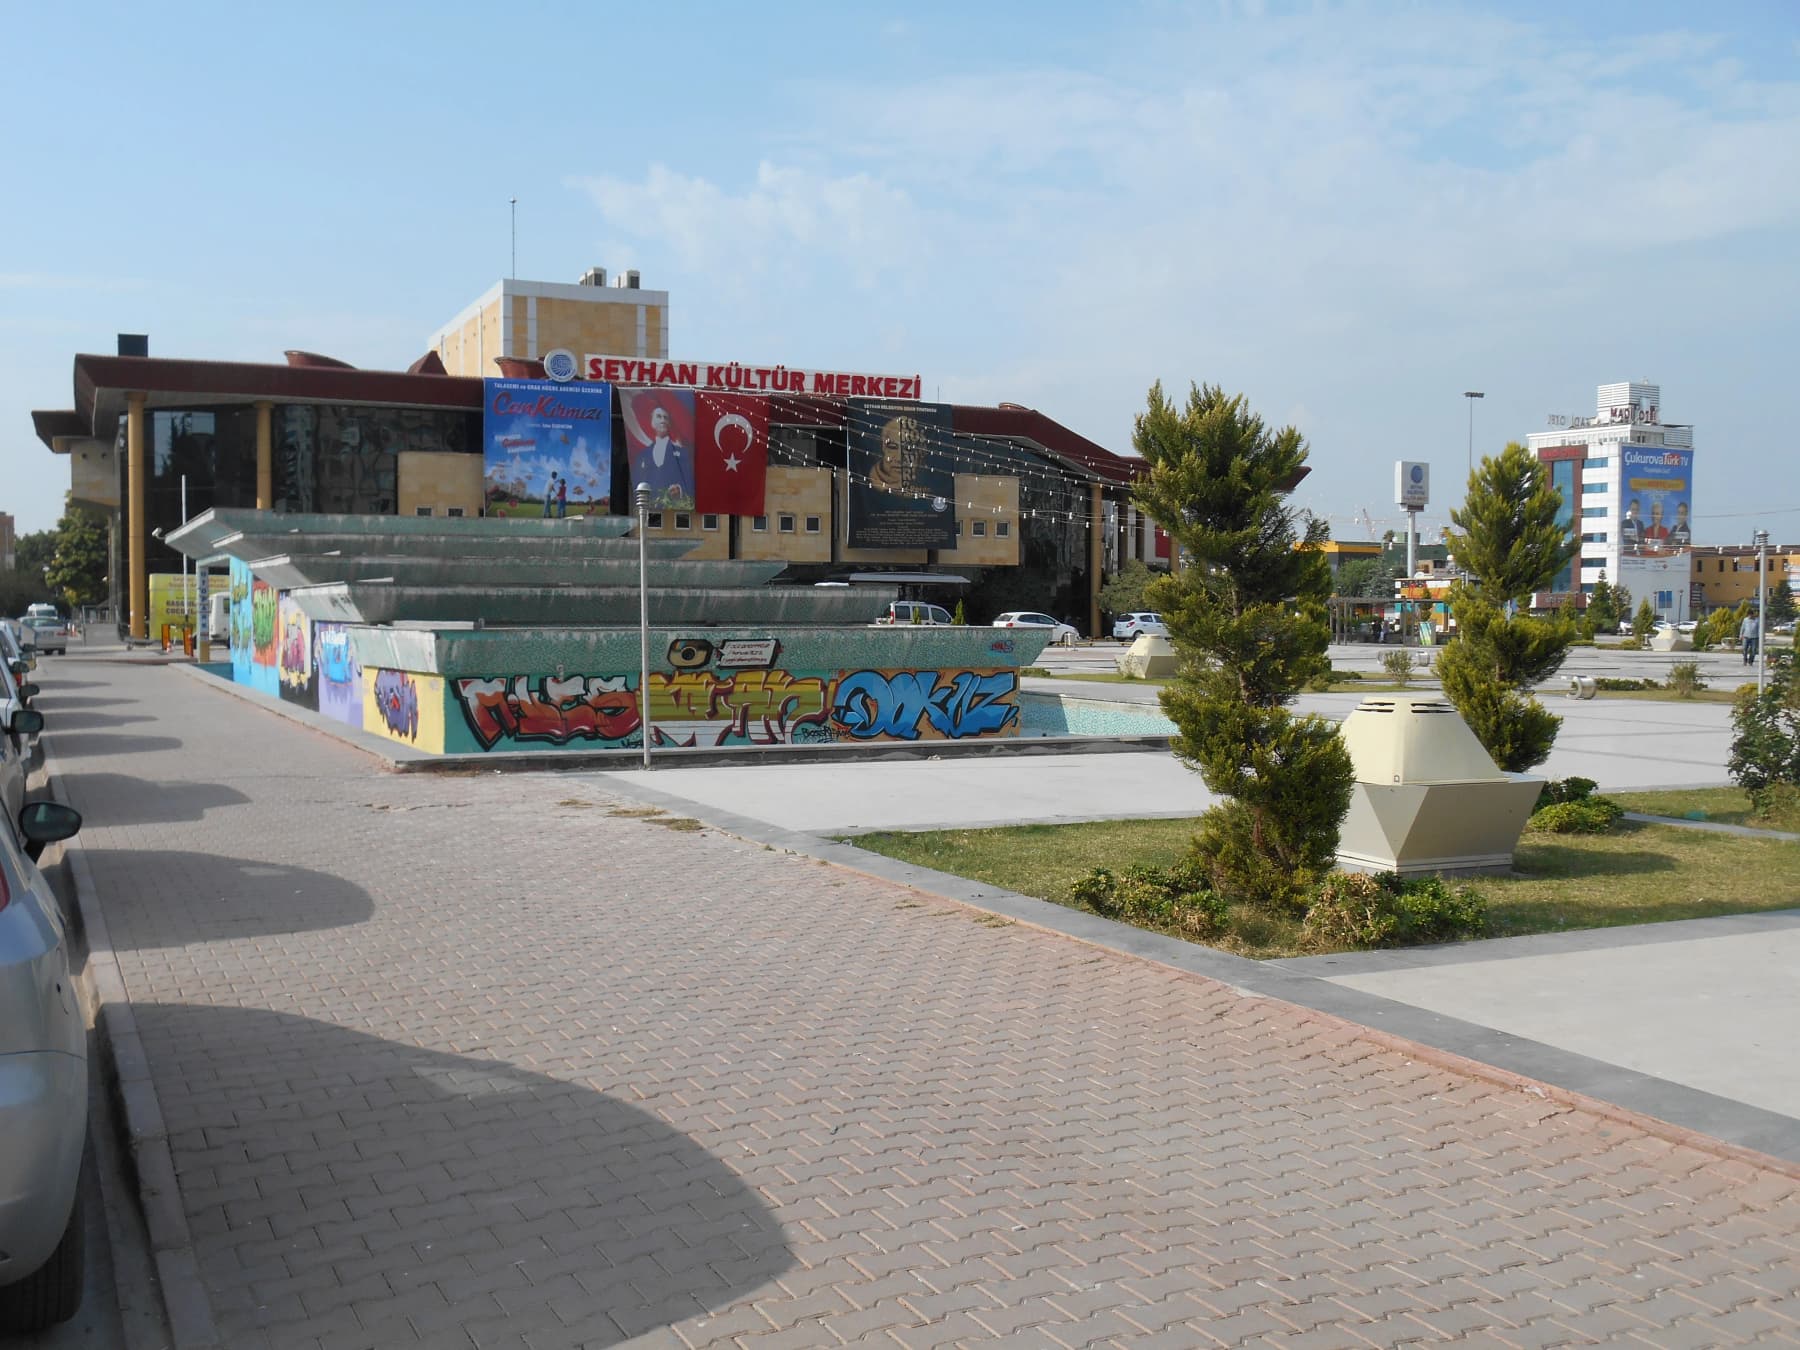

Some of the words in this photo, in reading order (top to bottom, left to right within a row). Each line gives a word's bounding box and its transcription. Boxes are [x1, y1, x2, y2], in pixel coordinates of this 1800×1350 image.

[589, 358, 698, 385] SEYHAN
[707, 361, 805, 391] KÜLTÜR
[814, 373, 921, 399] MERKEZİ
